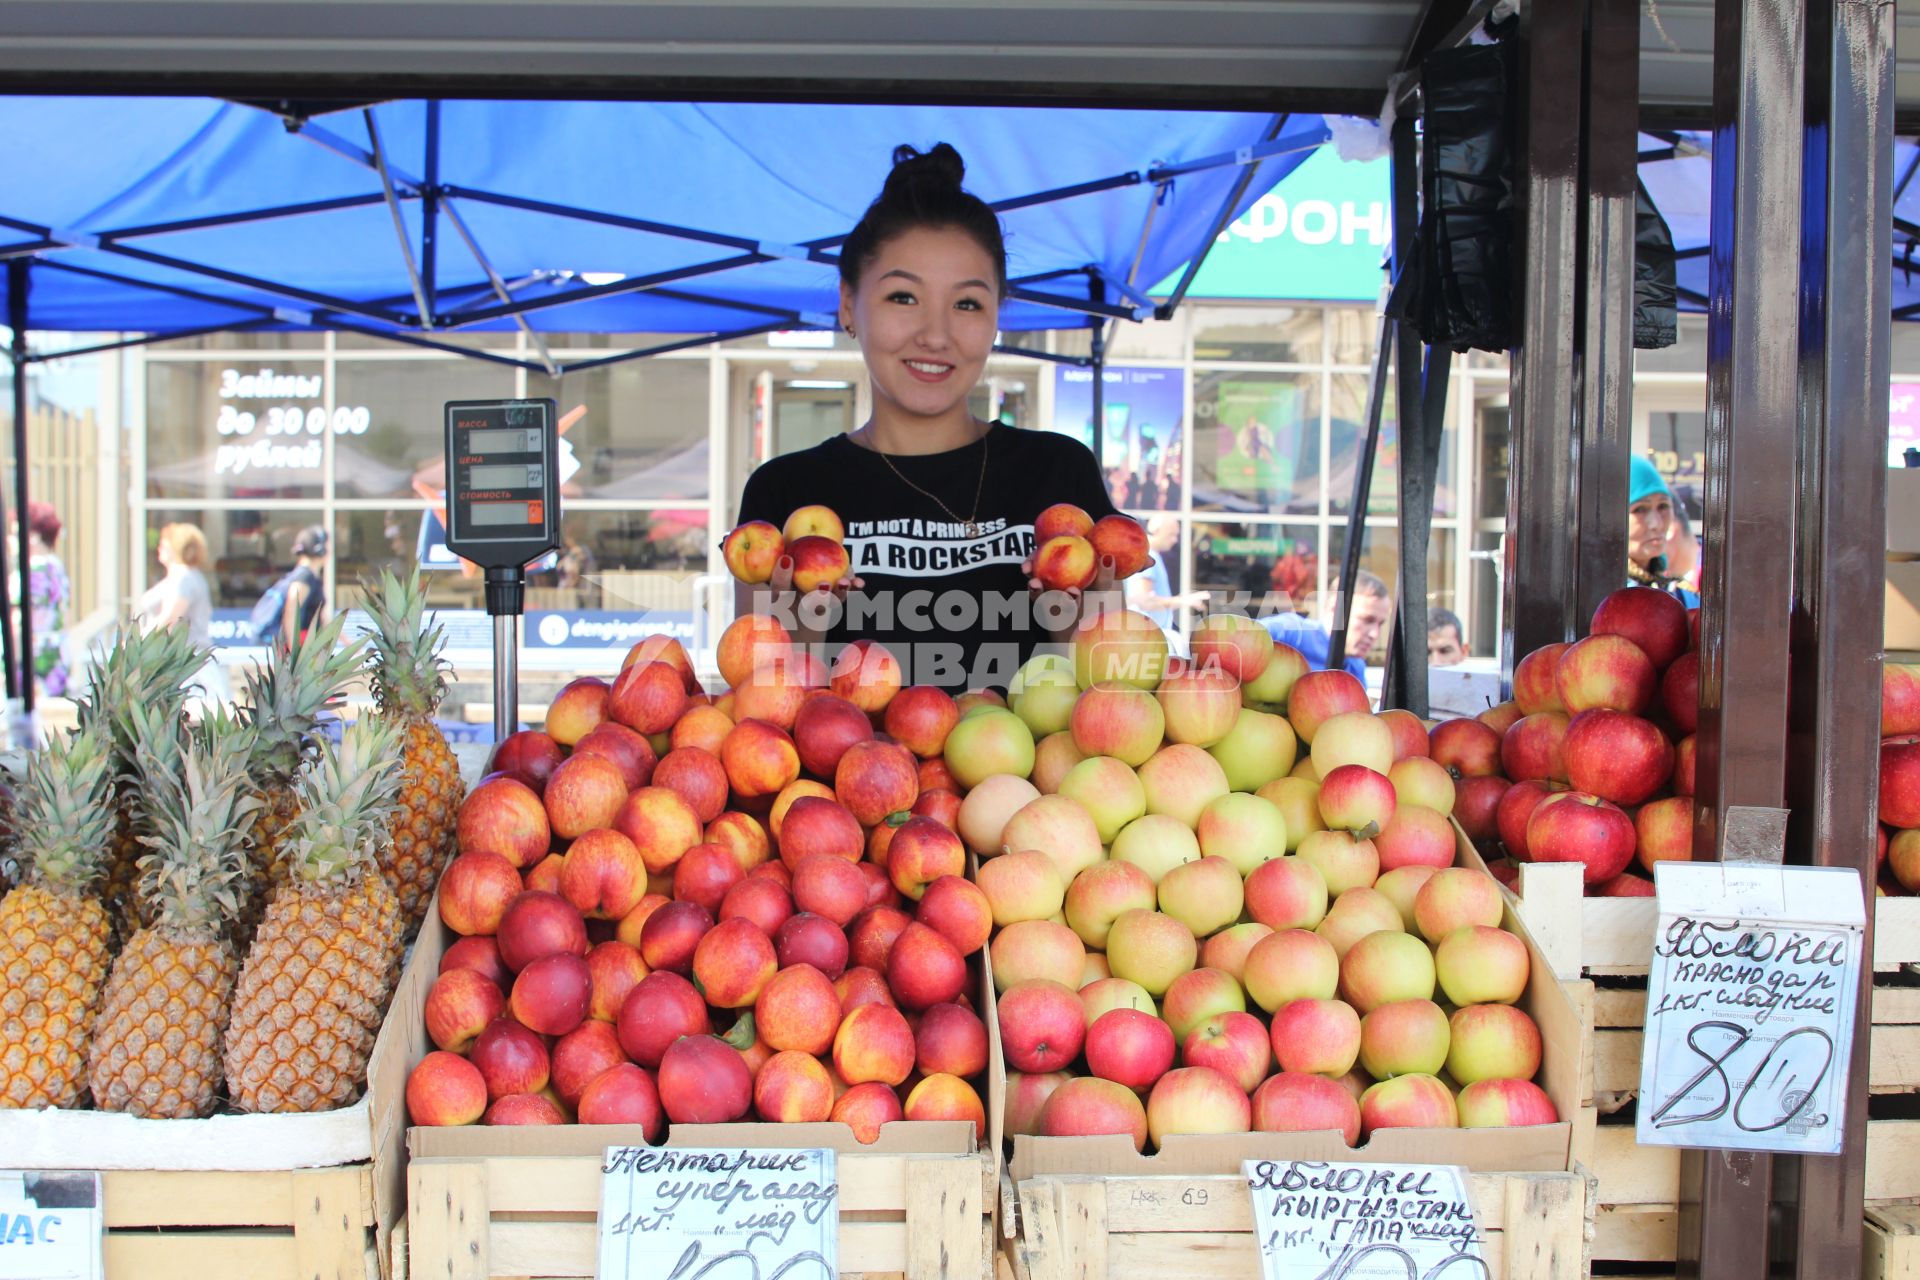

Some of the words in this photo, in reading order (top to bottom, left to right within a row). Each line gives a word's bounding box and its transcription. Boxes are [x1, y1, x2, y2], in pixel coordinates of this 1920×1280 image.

[219, 368, 322, 398] Займы
[217, 405, 256, 435] до
[214, 438, 322, 475] рублей
[458, 455, 484, 465] ЦЕНА
[459, 491, 512, 500] СТОИМОСТЬ
[849, 521, 873, 536] I'M
[877, 518, 910, 535] NOT
[912, 519, 924, 537] A
[861, 542, 881, 566] A
[888, 531, 1036, 571] ROCKSTAR
[1655, 916, 1844, 966] Яблоки
[1731, 1081, 1757, 1090] ЦЕА
[1248, 1160, 1438, 1197] Яблоки
